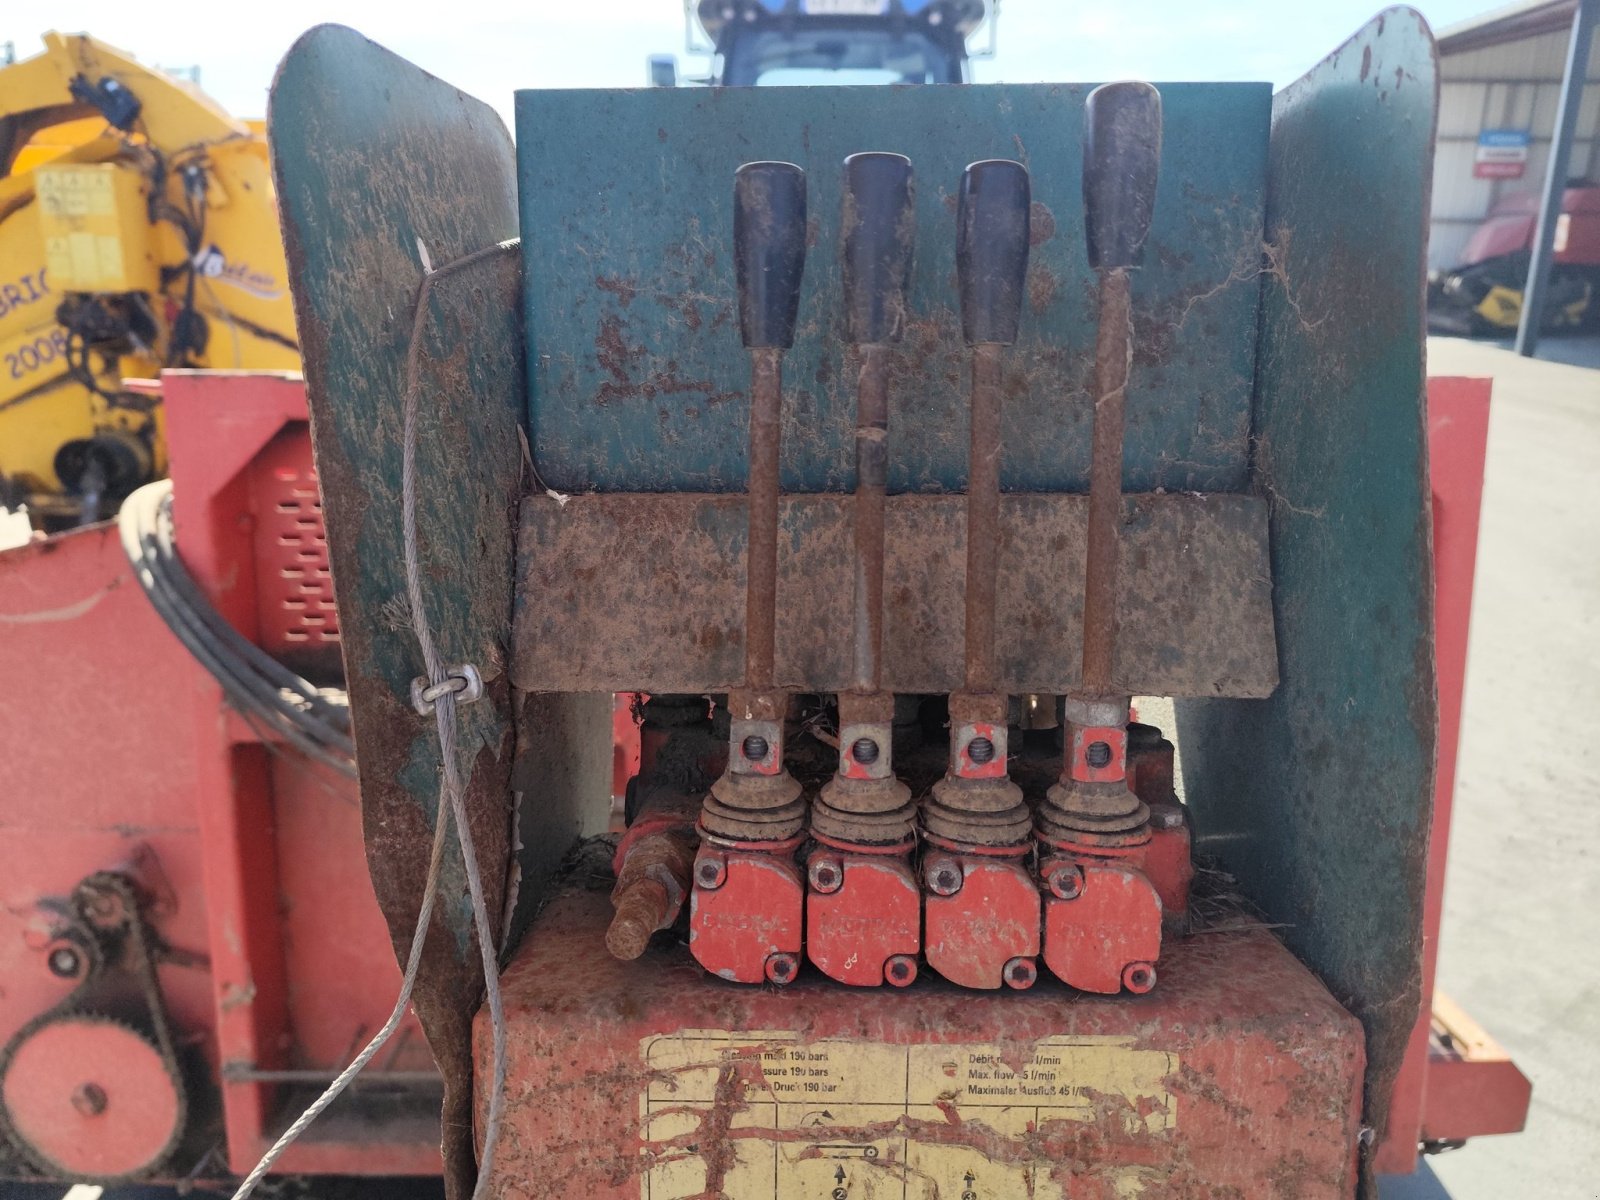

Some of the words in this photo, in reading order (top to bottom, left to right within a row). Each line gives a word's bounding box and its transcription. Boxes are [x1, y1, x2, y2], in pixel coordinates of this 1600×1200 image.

[790, 1051, 805, 1060] 190
[1035, 1055, 1061, 1065] l/min
[790, 1066, 805, 1077] 190
[808, 1066, 829, 1077] bars
[968, 1070, 992, 1080] Max.
[1031, 1070, 1056, 1080] l/min
[803, 1082, 819, 1092] 190
[822, 1082, 837, 1092] bar
[968, 1085, 1017, 1095] Maximaler
[1058, 1085, 1070, 1096] 45
